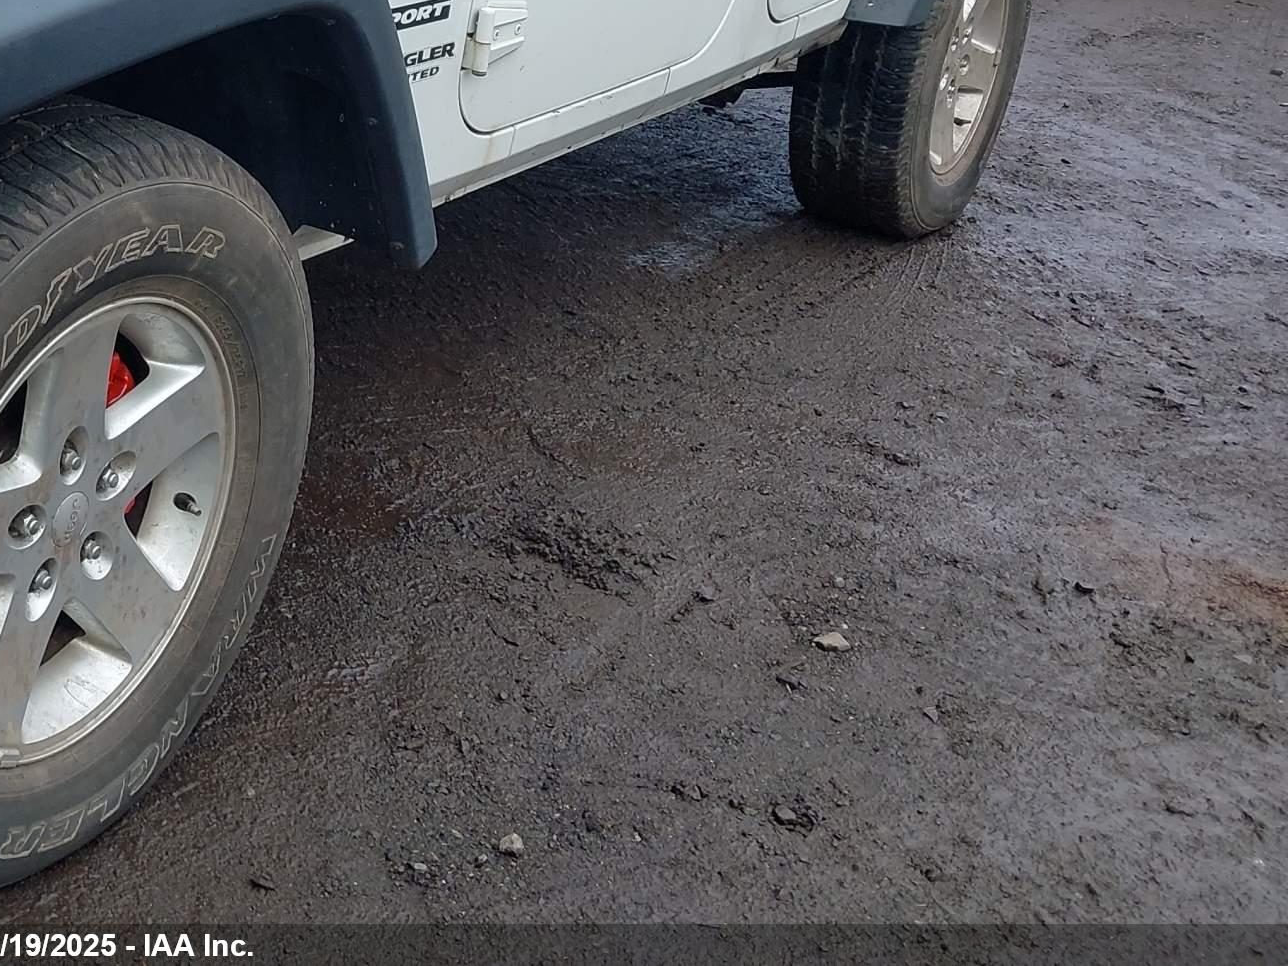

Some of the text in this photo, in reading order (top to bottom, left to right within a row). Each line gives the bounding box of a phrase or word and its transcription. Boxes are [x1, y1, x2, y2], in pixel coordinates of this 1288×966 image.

[392, 0, 452, 26] PORT
[403, 41, 456, 68] GLER
[408, 66, 440, 82] TED
